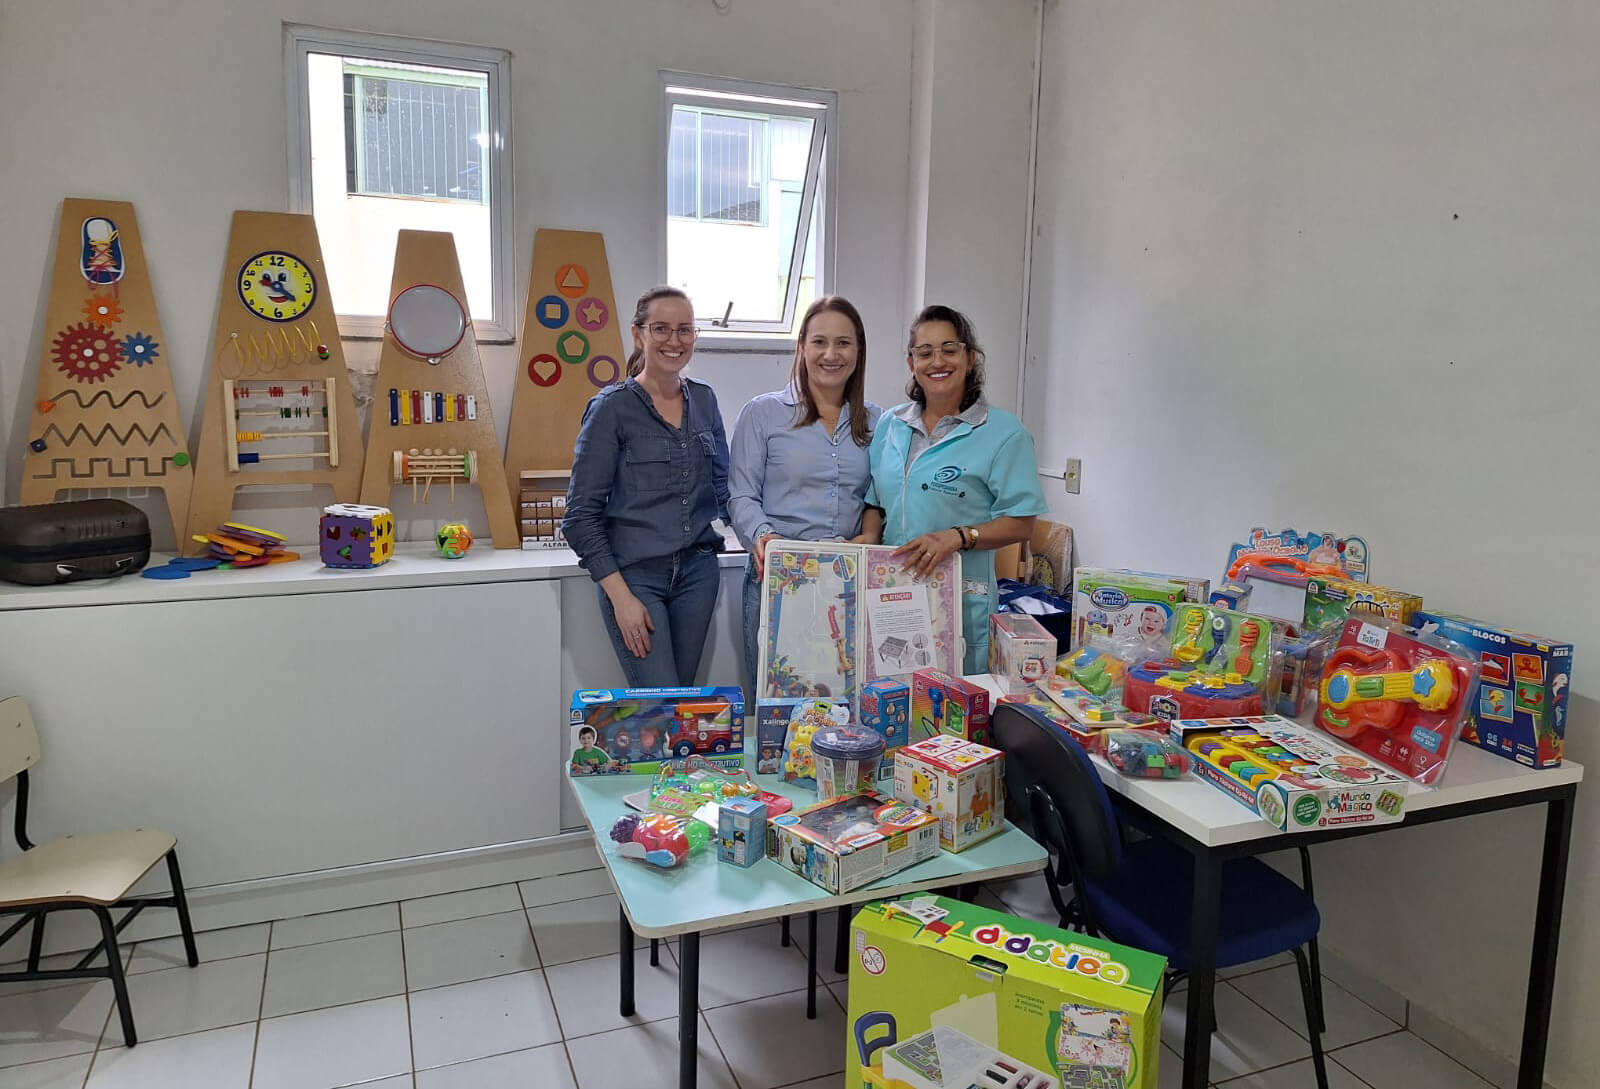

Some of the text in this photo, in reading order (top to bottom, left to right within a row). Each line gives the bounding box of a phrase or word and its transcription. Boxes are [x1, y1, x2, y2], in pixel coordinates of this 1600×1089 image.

[269, 255, 285, 267] 12
[243, 280, 251, 291] 9
[305, 283, 312, 294] 3
[274, 307, 283, 318] 6
[1472, 629, 1506, 644] BLOCOS
[1341, 791, 1371, 801] Mundo
